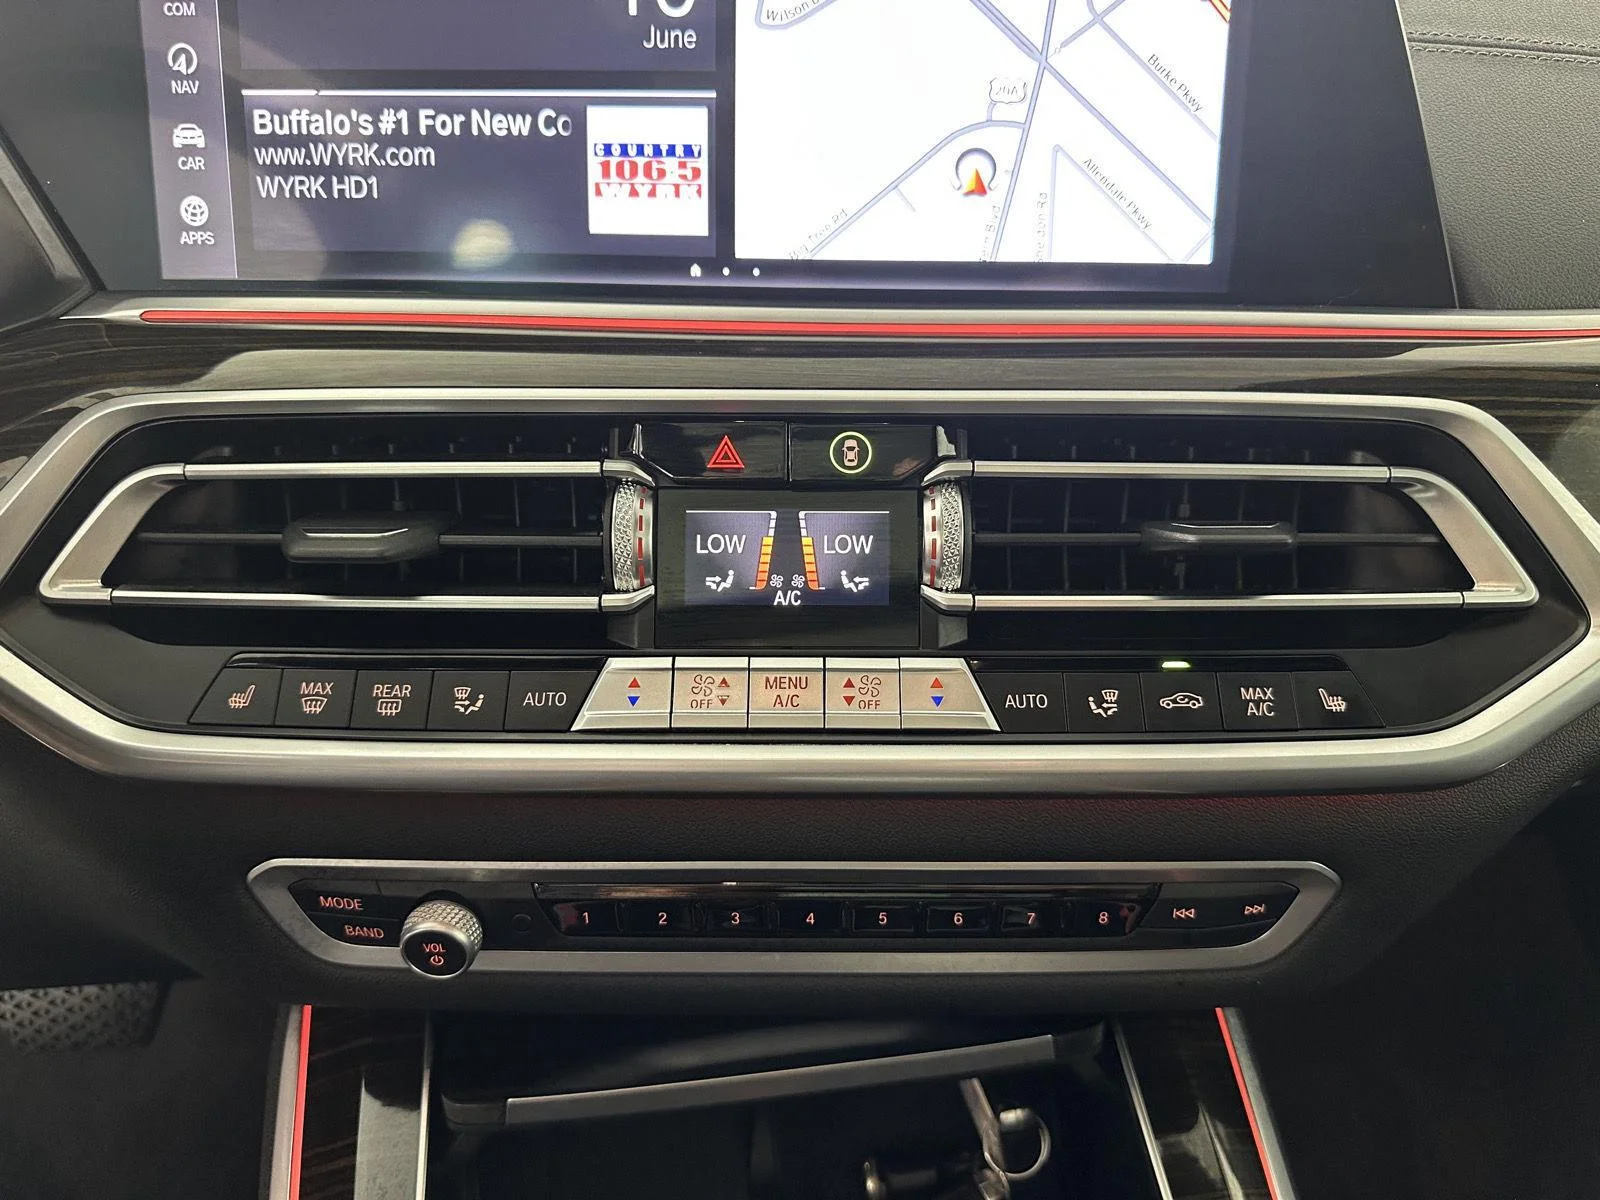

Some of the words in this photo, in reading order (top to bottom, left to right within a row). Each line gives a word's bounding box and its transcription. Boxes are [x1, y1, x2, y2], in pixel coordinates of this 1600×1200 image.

[163, 2, 196, 16] COM
[766, 2, 810, 22] Wilson
[643, 24, 697, 49] June
[171, 80, 199, 94] NAV
[1147, 53, 1177, 88] Burke
[1176, 83, 1204, 113] Pkwy
[253, 108, 374, 136] Buffalo's
[378, 108, 409, 135] #1
[418, 108, 465, 136] For
[471, 108, 532, 137] New
[537, 108, 573, 137] Co
[254, 142, 436, 168] www.WYRK.com
[594, 143, 702, 159] COUNTRY
[178, 156, 206, 171] CAR
[256, 175, 327, 199] WYRK
[331, 176, 379, 200] HD1
[1126, 200, 1153, 231] Pkwy
[180, 231, 215, 245] APPS
[696, 534, 747, 554] LOW
[823, 534, 874, 555] LOW
[773, 590, 802, 606] A/C
[300, 681, 334, 696] MAX
[764, 675, 809, 690] MENU
[373, 684, 411, 698] REAR
[1240, 686, 1274, 701] MAX
[523, 692, 567, 708] AUTO
[690, 699, 714, 710] OFF
[773, 694, 801, 709] A/C
[858, 699, 881, 710] OFF
[1005, 694, 1048, 709] AUTO
[1247, 702, 1275, 717] A/C
[319, 895, 364, 911] MODE
[582, 912, 590, 925] 1
[658, 912, 668, 925] 2
[730, 912, 741, 925] 3
[805, 912, 816, 925] 4
[878, 912, 888, 925] 5
[953, 912, 964, 925] 6
[1026, 912, 1037, 925] 7
[1098, 911, 1109, 925] 8
[344, 924, 384, 940] BAND
[423, 942, 446, 954] VOL
